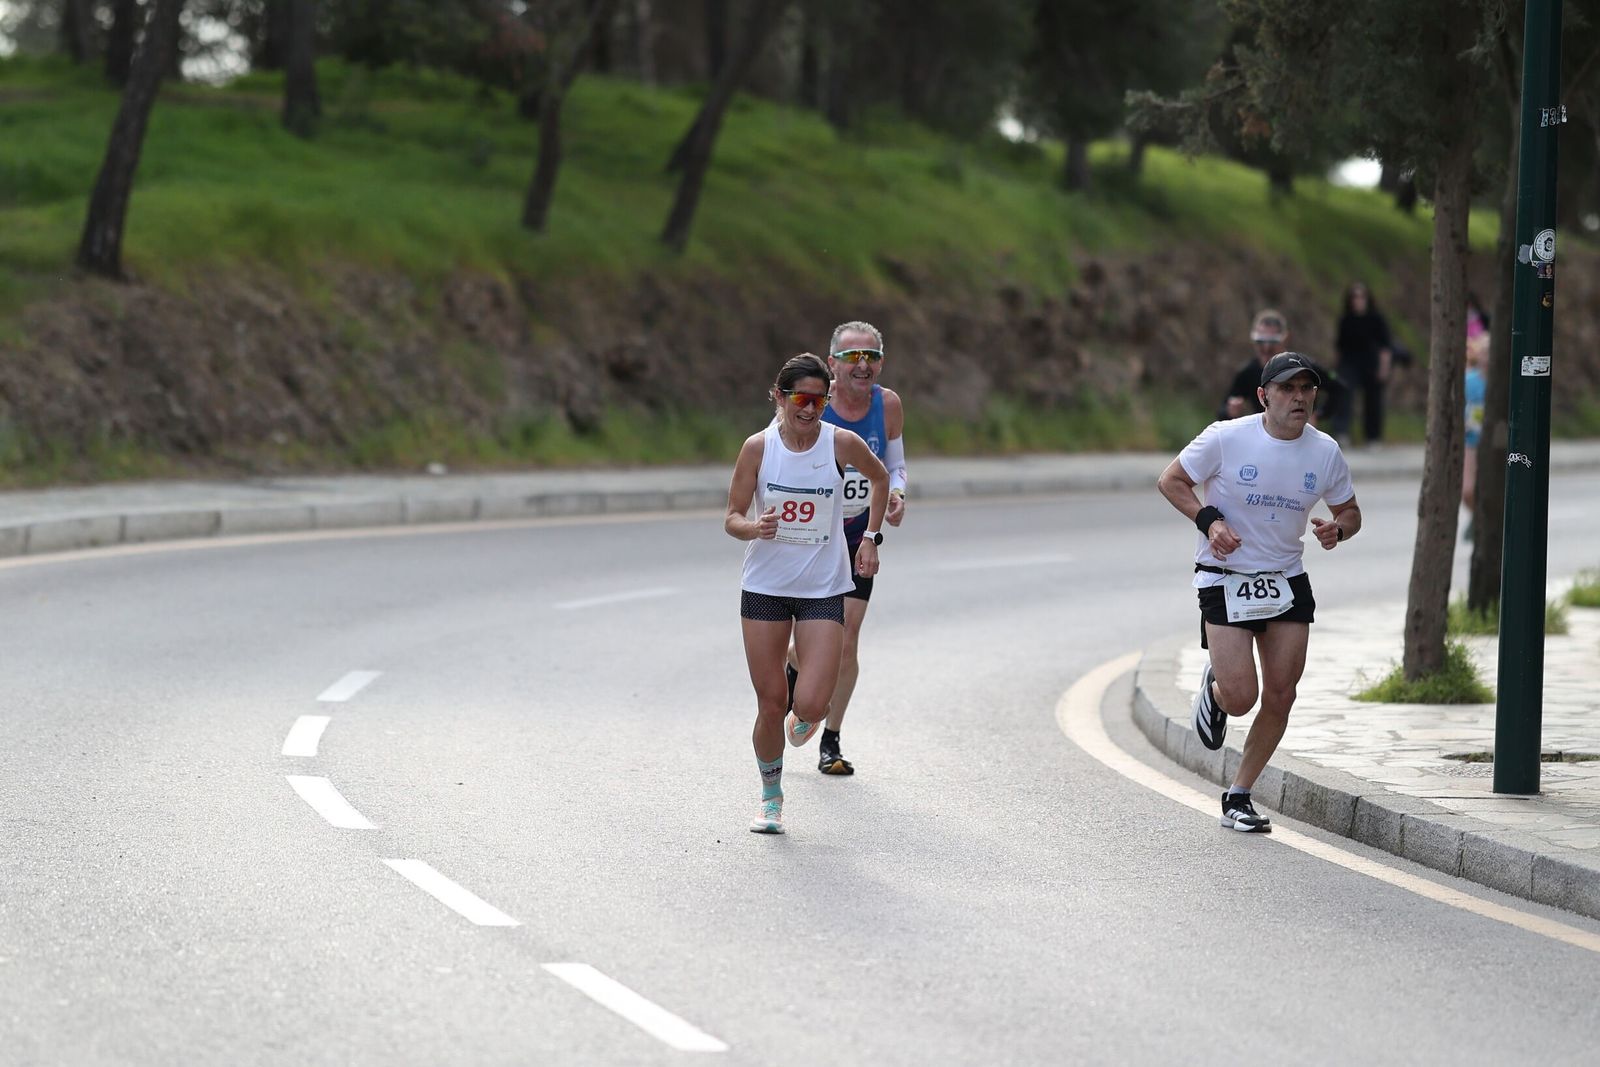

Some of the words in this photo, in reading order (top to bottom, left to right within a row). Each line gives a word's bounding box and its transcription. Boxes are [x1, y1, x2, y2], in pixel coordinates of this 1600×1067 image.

[1243, 468, 1254, 476] FIAT
[1246, 493, 1261, 506] 43
[781, 500, 815, 523] 89
[1236, 578, 1281, 600] 485
